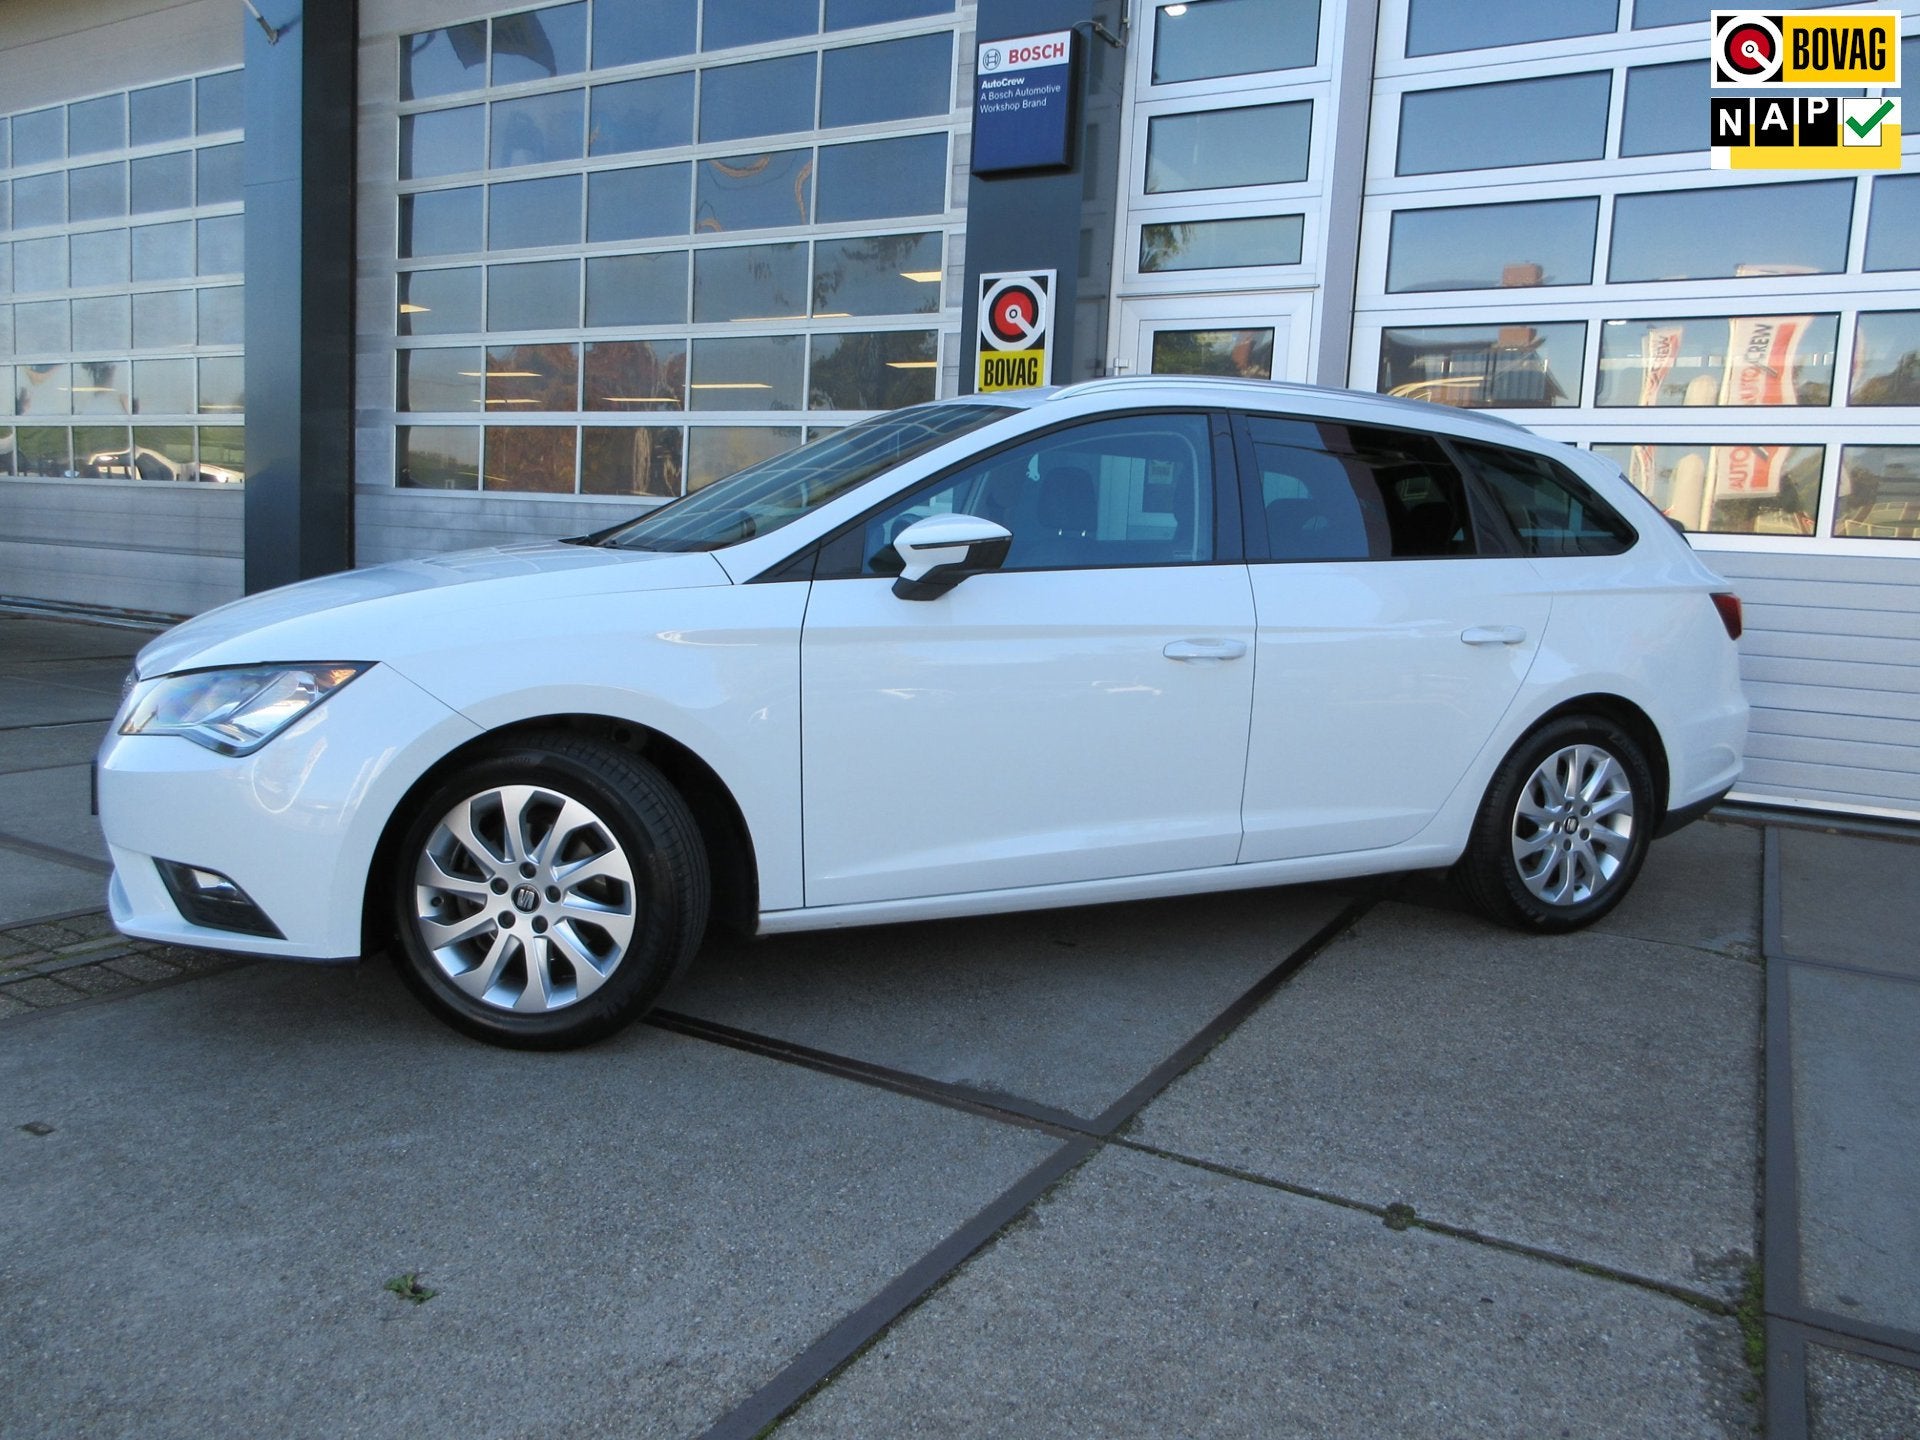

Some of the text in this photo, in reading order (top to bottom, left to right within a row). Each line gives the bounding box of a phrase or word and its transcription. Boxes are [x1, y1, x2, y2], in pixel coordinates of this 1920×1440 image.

[1008, 43, 1065, 64] BOSCH
[981, 77, 1025, 89] AutoCrew
[980, 84, 1061, 101] A Bosch Automotive
[980, 98, 1047, 113] Workshop Brand
[983, 357, 1038, 387] BOVAG
